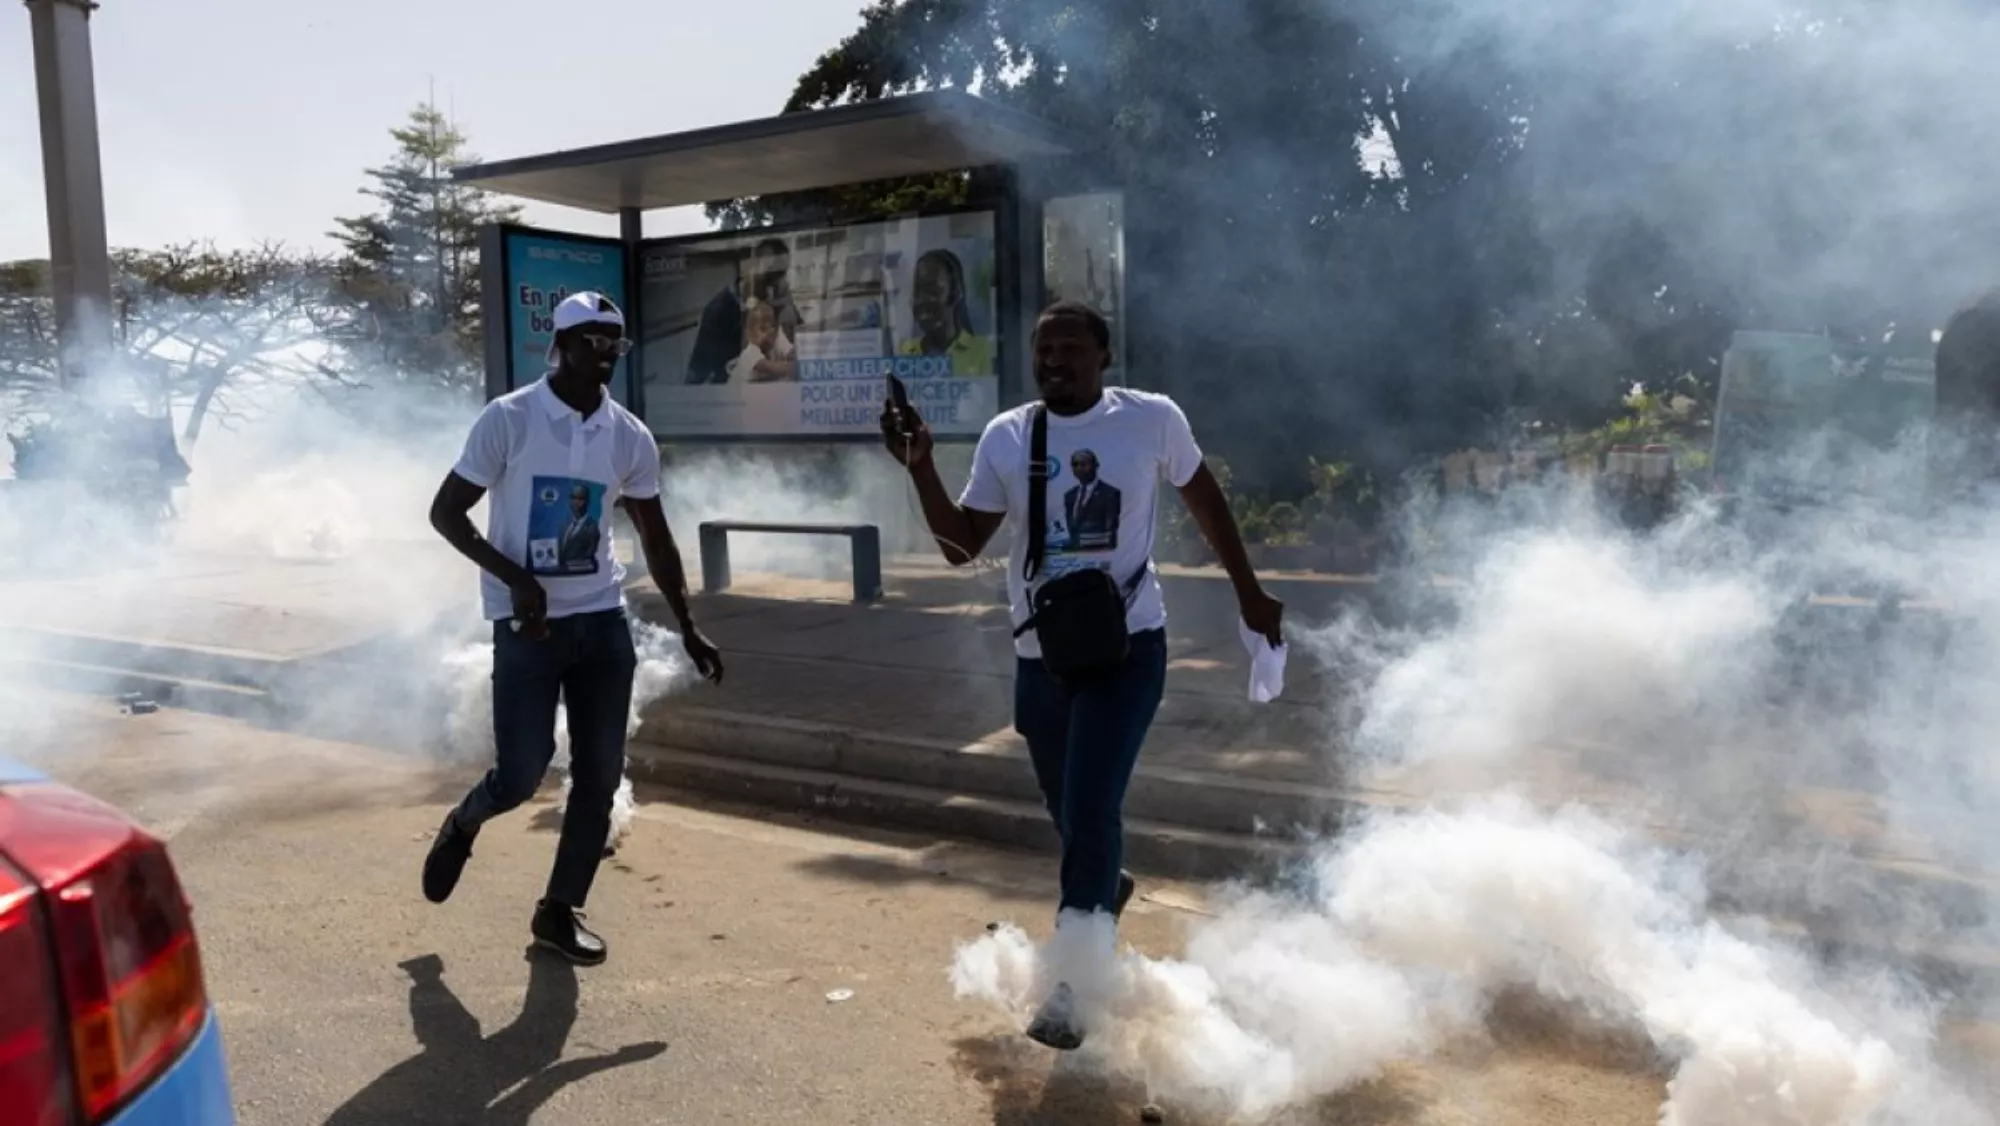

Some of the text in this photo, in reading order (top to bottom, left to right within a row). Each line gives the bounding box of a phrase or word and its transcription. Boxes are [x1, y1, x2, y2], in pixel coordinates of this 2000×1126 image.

[518, 284, 543, 307] En
[800, 360, 823, 380] UN
[801, 383, 847, 402] POUR
[848, 382, 872, 401] UN
[948, 381, 971, 400] DE
